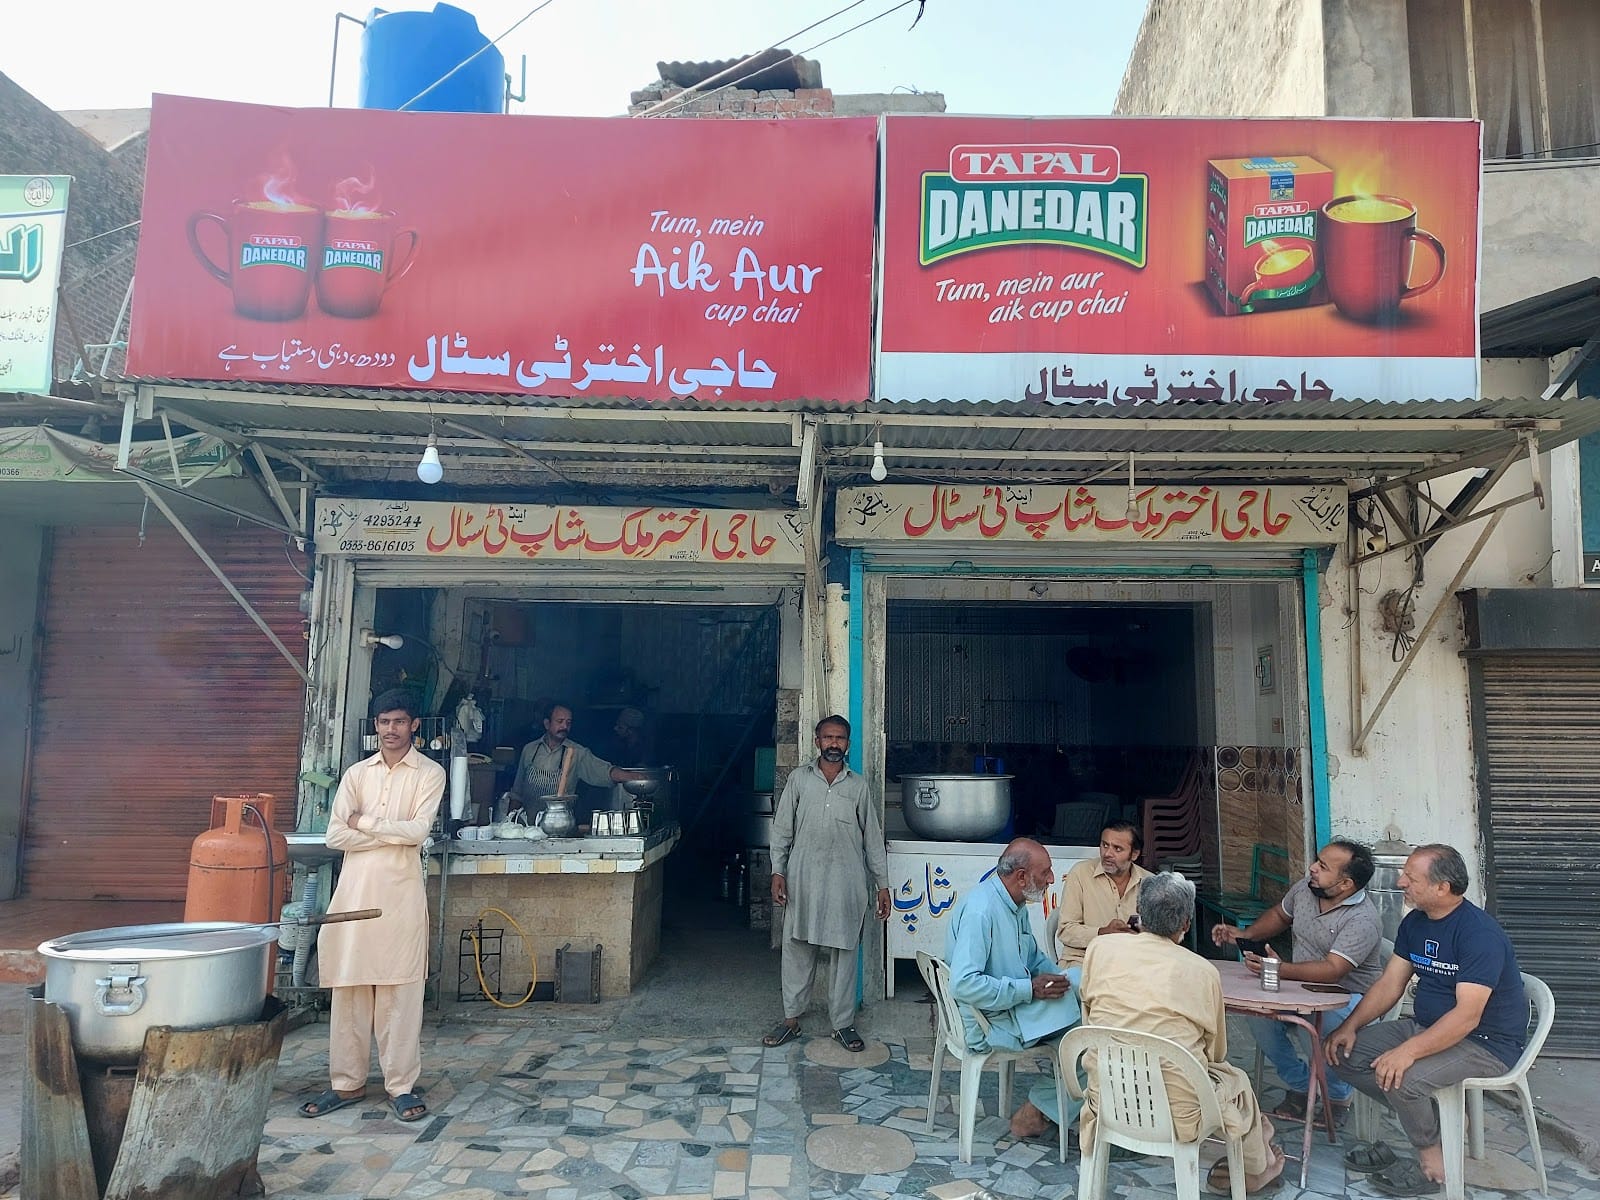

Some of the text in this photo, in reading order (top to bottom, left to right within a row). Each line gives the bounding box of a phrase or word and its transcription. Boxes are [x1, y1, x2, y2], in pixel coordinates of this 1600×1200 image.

[960, 152, 1111, 177] TAPAL
[650, 210, 765, 238] Tum, mein
[928, 189, 1137, 254] DANEDAR
[1257, 204, 1306, 216] TAPAL
[253, 236, 299, 247] TAPAL
[335, 241, 375, 250] TAPAL
[1246, 216, 1314, 243] DANEDAR
[242, 247, 306, 268] DANEDAR
[325, 250, 382, 270] DANEDAR
[630, 240, 823, 301] Aik Aur
[935, 271, 1104, 303] Tum, mein aur
[704, 298, 803, 328] cup chai
[988, 289, 1129, 324] aik cup chai
[217, 343, 250, 372] ہے
[252, 338, 316, 371] دستیاب
[407, 331, 778, 396] حاجی اختر ٹی سٹال
[362, 514, 422, 528] 4293244
[425, 504, 486, 553] سٹال
[903, 485, 980, 537] سٹال
[978, 485, 1008, 539] ٹی
[1014, 486, 1098, 540] شاپ
[1151, 485, 1220, 541] اختر
[1220, 487, 1293, 542] حاجی
[482, 503, 509, 555] ٹی
[509, 508, 586, 557] شاپ
[642, 507, 708, 558] اختر
[711, 511, 777, 561] حاجی
